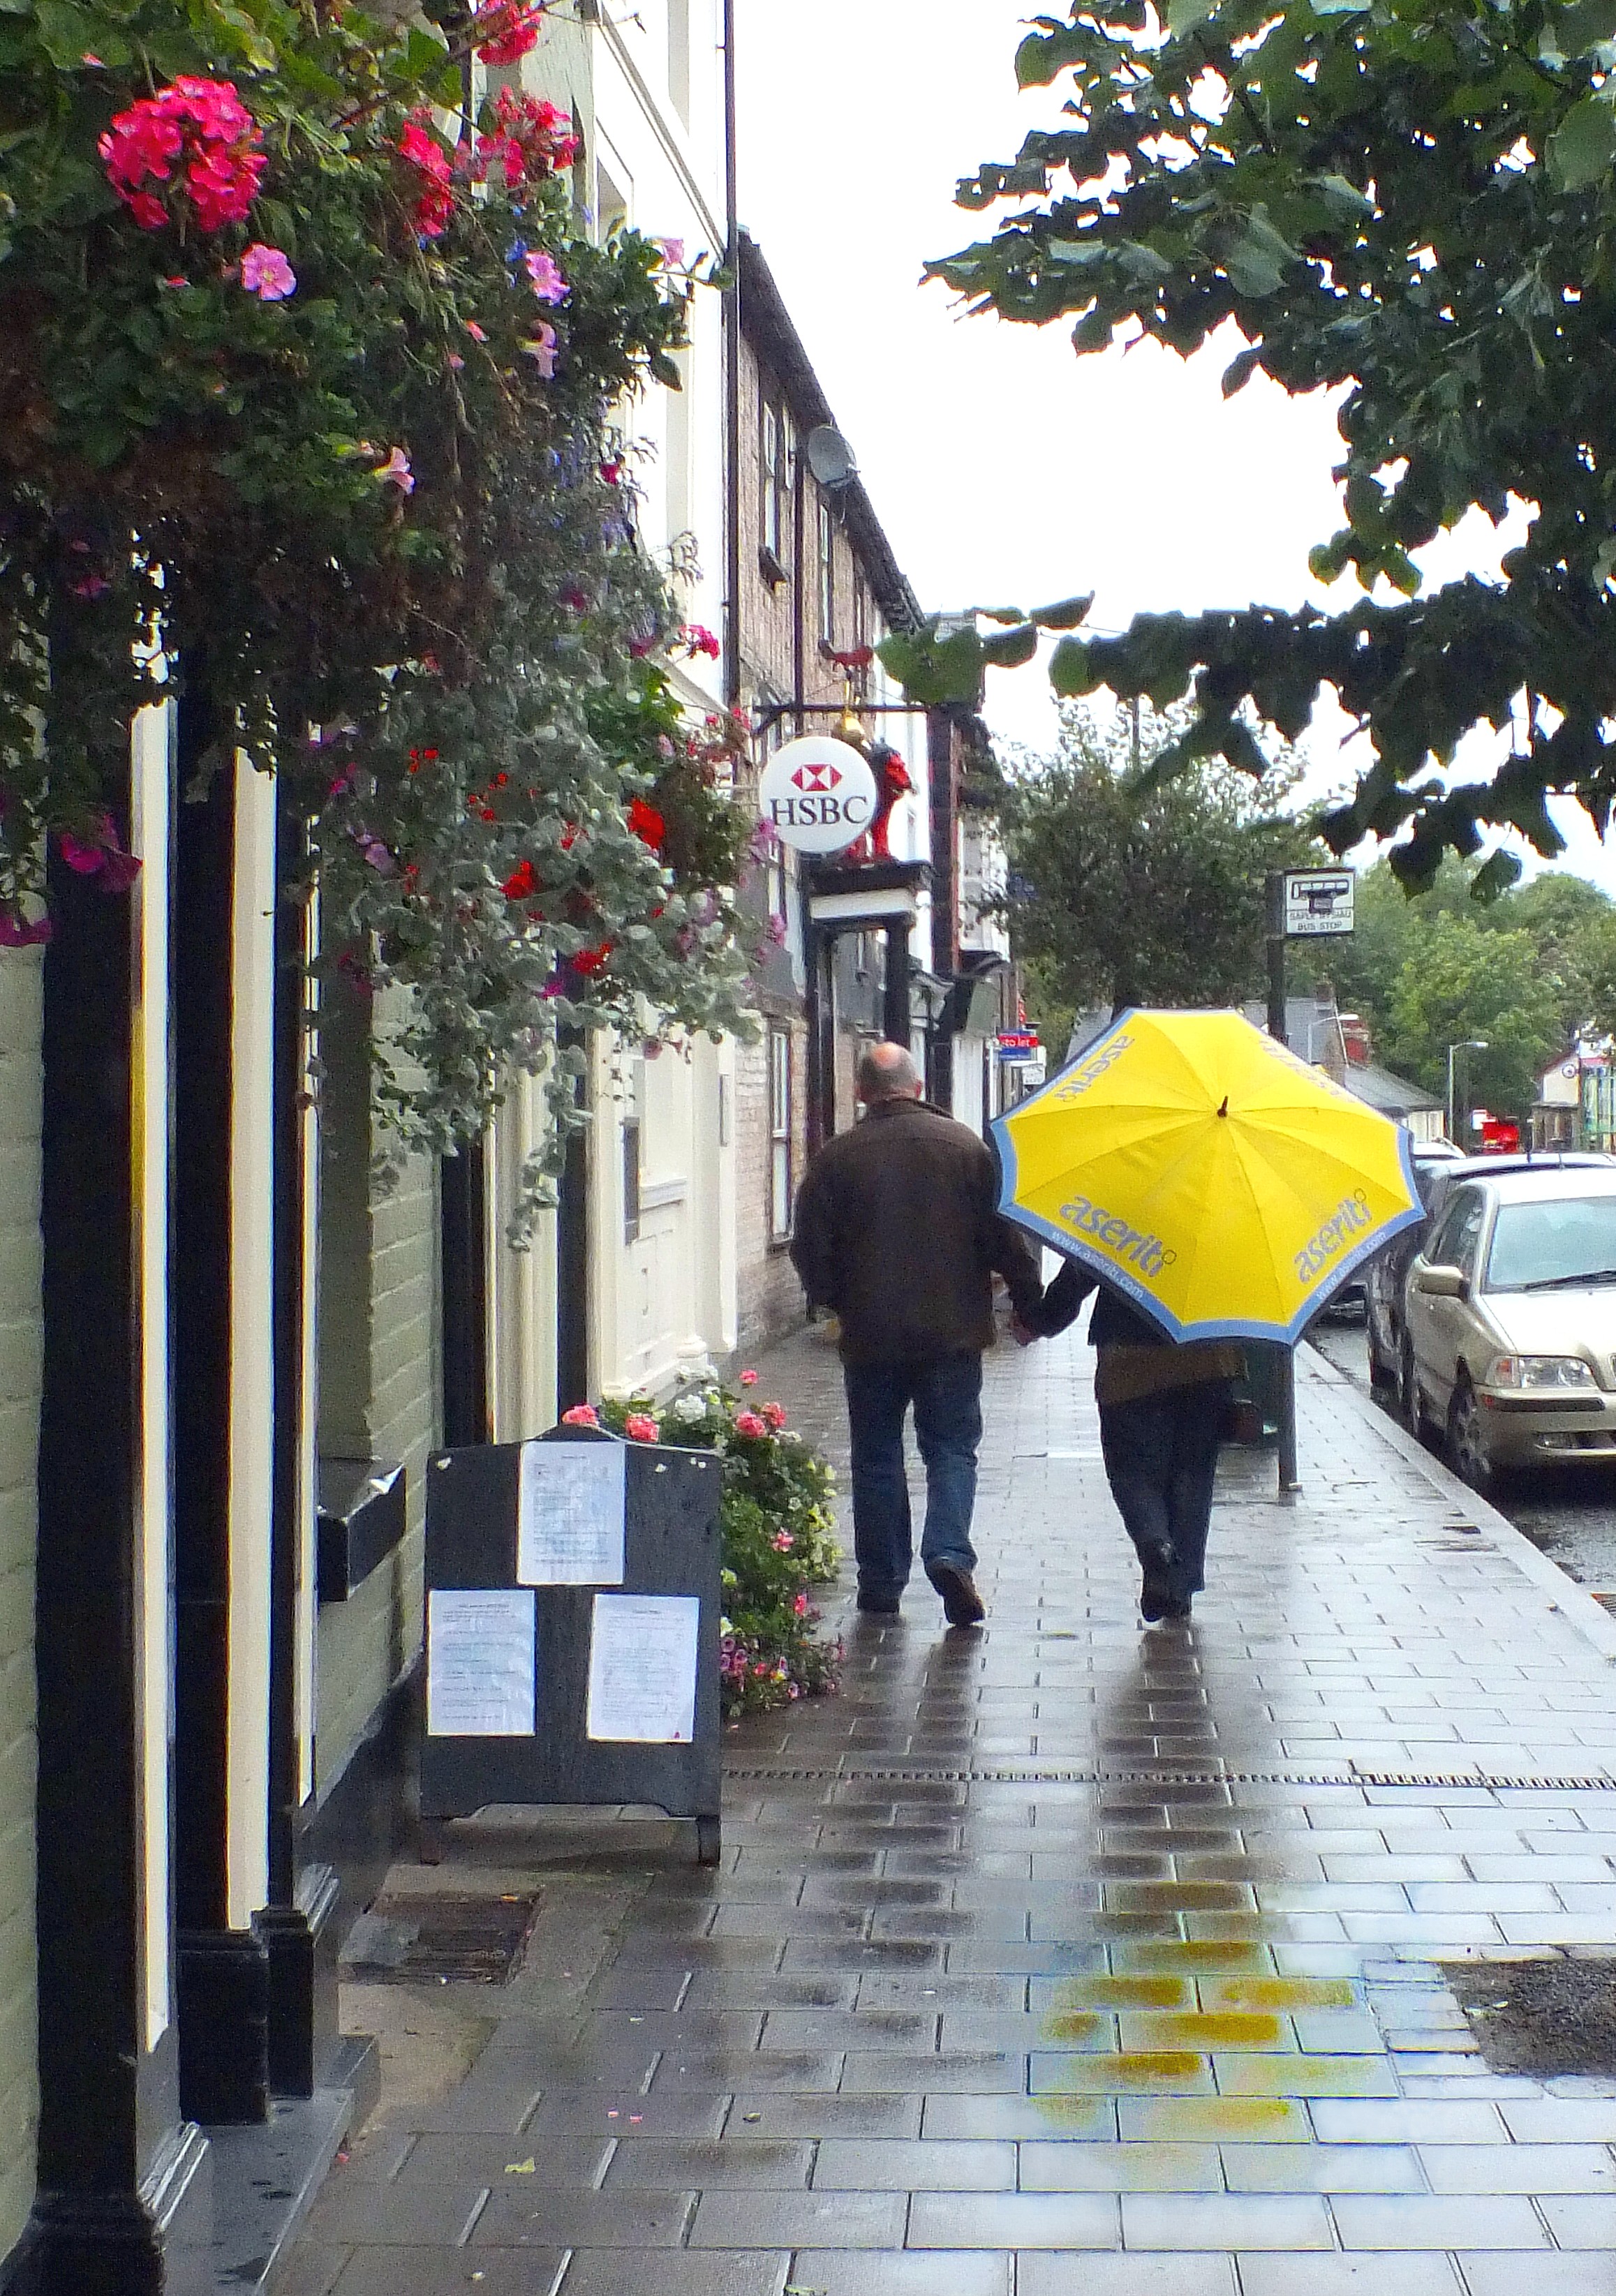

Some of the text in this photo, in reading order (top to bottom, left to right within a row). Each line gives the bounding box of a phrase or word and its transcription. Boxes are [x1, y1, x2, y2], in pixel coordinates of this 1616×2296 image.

[771, 796, 868, 826] HSBC
[1297, 921, 1342, 931] BUS STOP
[1005, 1036, 1030, 1047] to let
